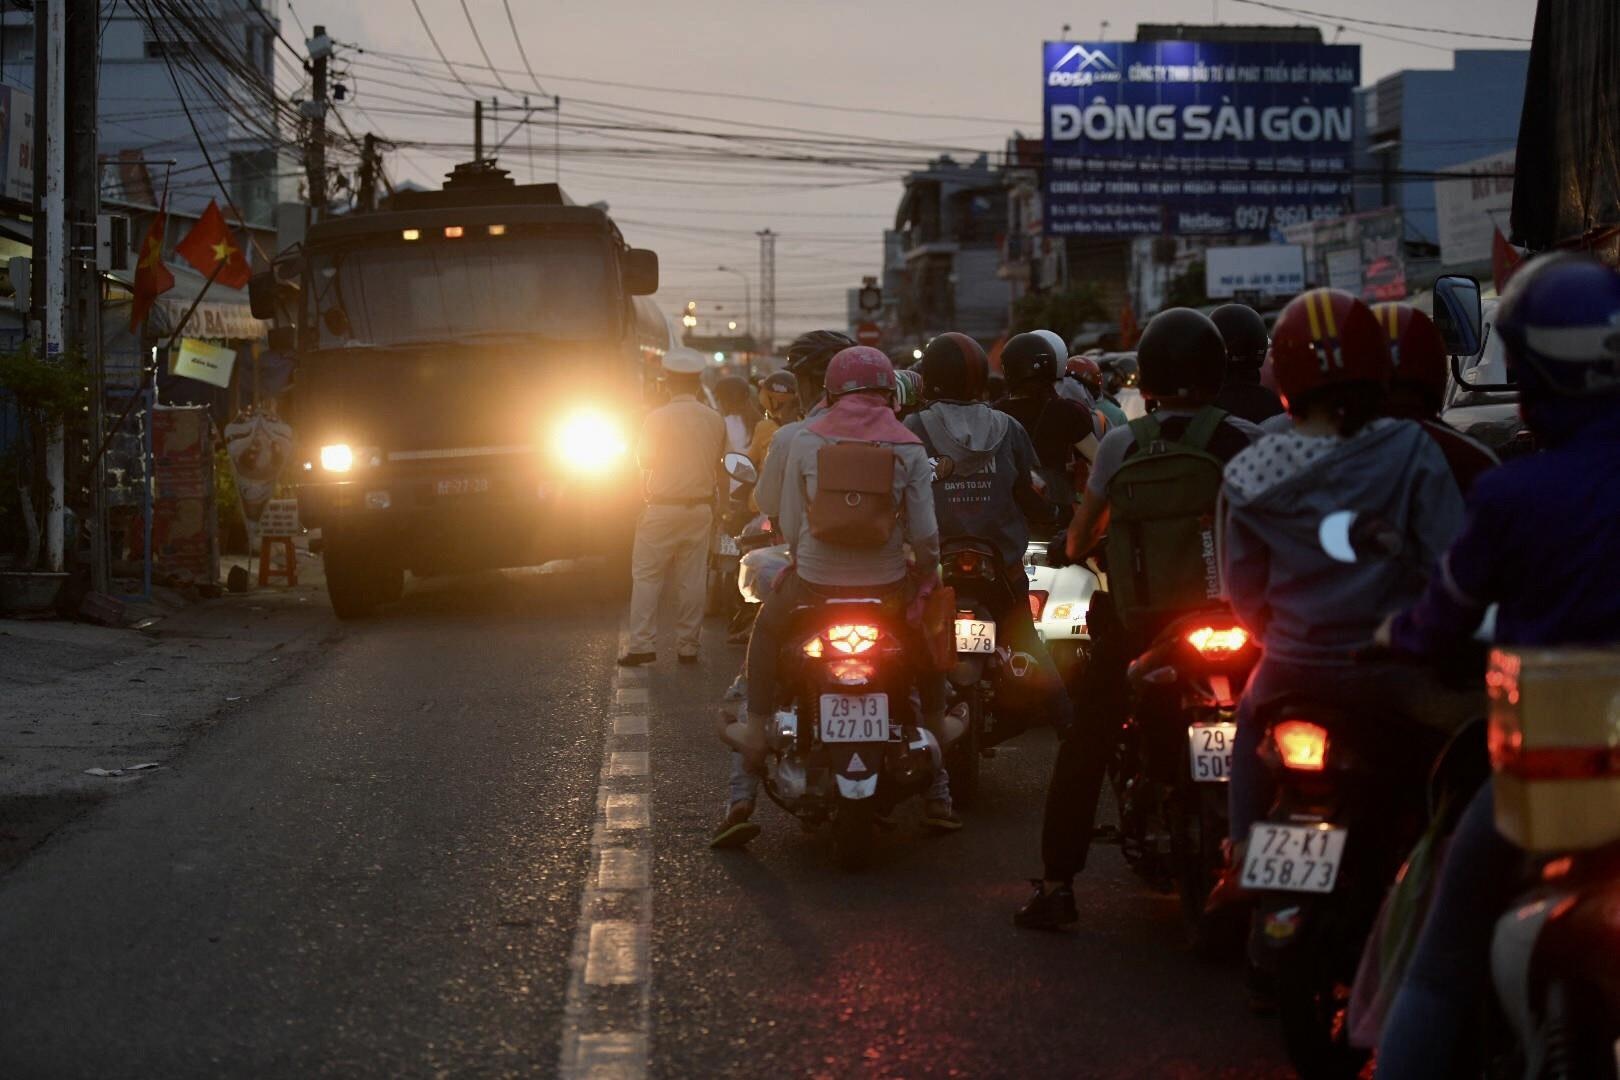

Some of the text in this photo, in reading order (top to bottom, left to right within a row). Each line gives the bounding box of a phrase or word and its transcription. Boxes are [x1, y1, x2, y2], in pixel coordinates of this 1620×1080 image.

[1050, 95, 1353, 142] ĐÔNG SÀI GÒN
[1201, 529, 1218, 600] Heineken
[831, 698, 878, 717] 29-Y3
[826, 719, 883, 739] 427.01
[1262, 829, 1330, 857] 72-K1
[1246, 858, 1334, 888] 458.73
